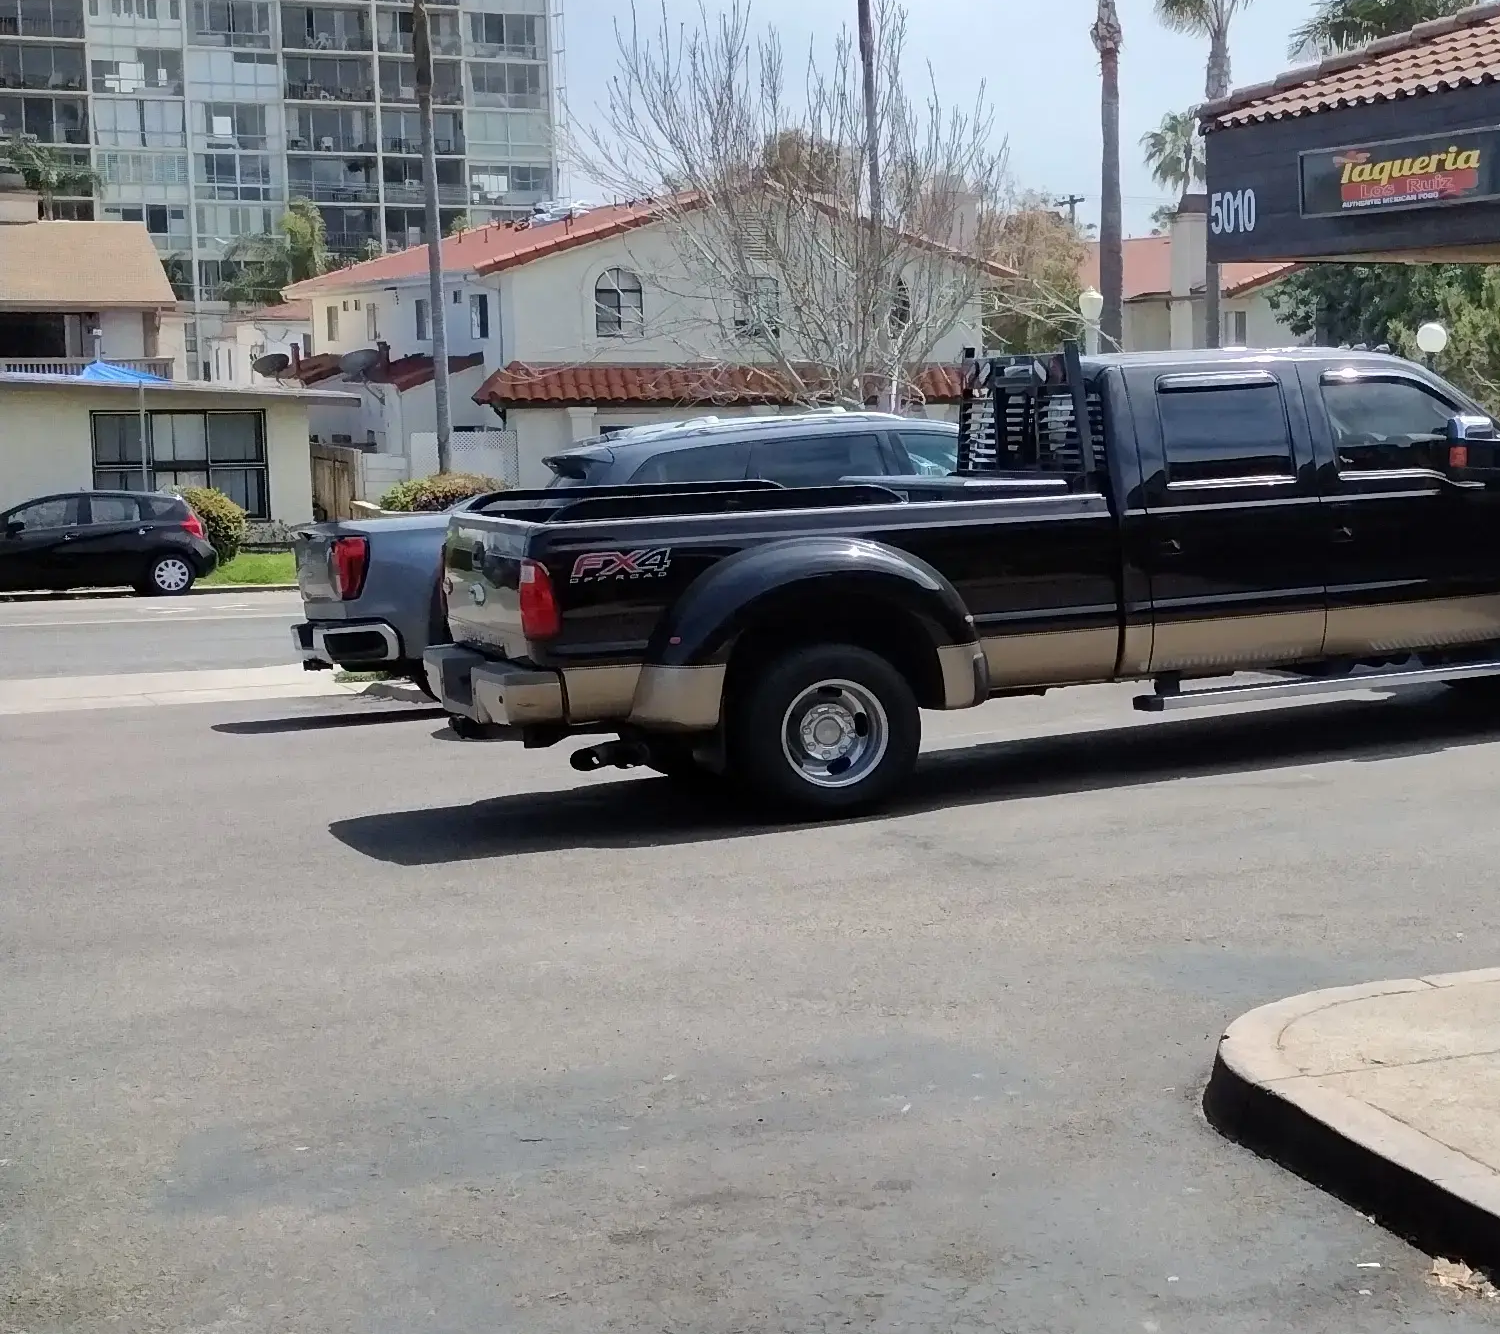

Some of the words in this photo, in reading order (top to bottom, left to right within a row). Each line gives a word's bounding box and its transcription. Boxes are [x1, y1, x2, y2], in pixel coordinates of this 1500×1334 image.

[1340, 145, 1481, 186] Taqueria
[1360, 183, 1395, 199] Los
[1406, 174, 1456, 194] Ruiz
[1210, 188, 1256, 235] 5010
[570, 547, 672, 578] FX4
